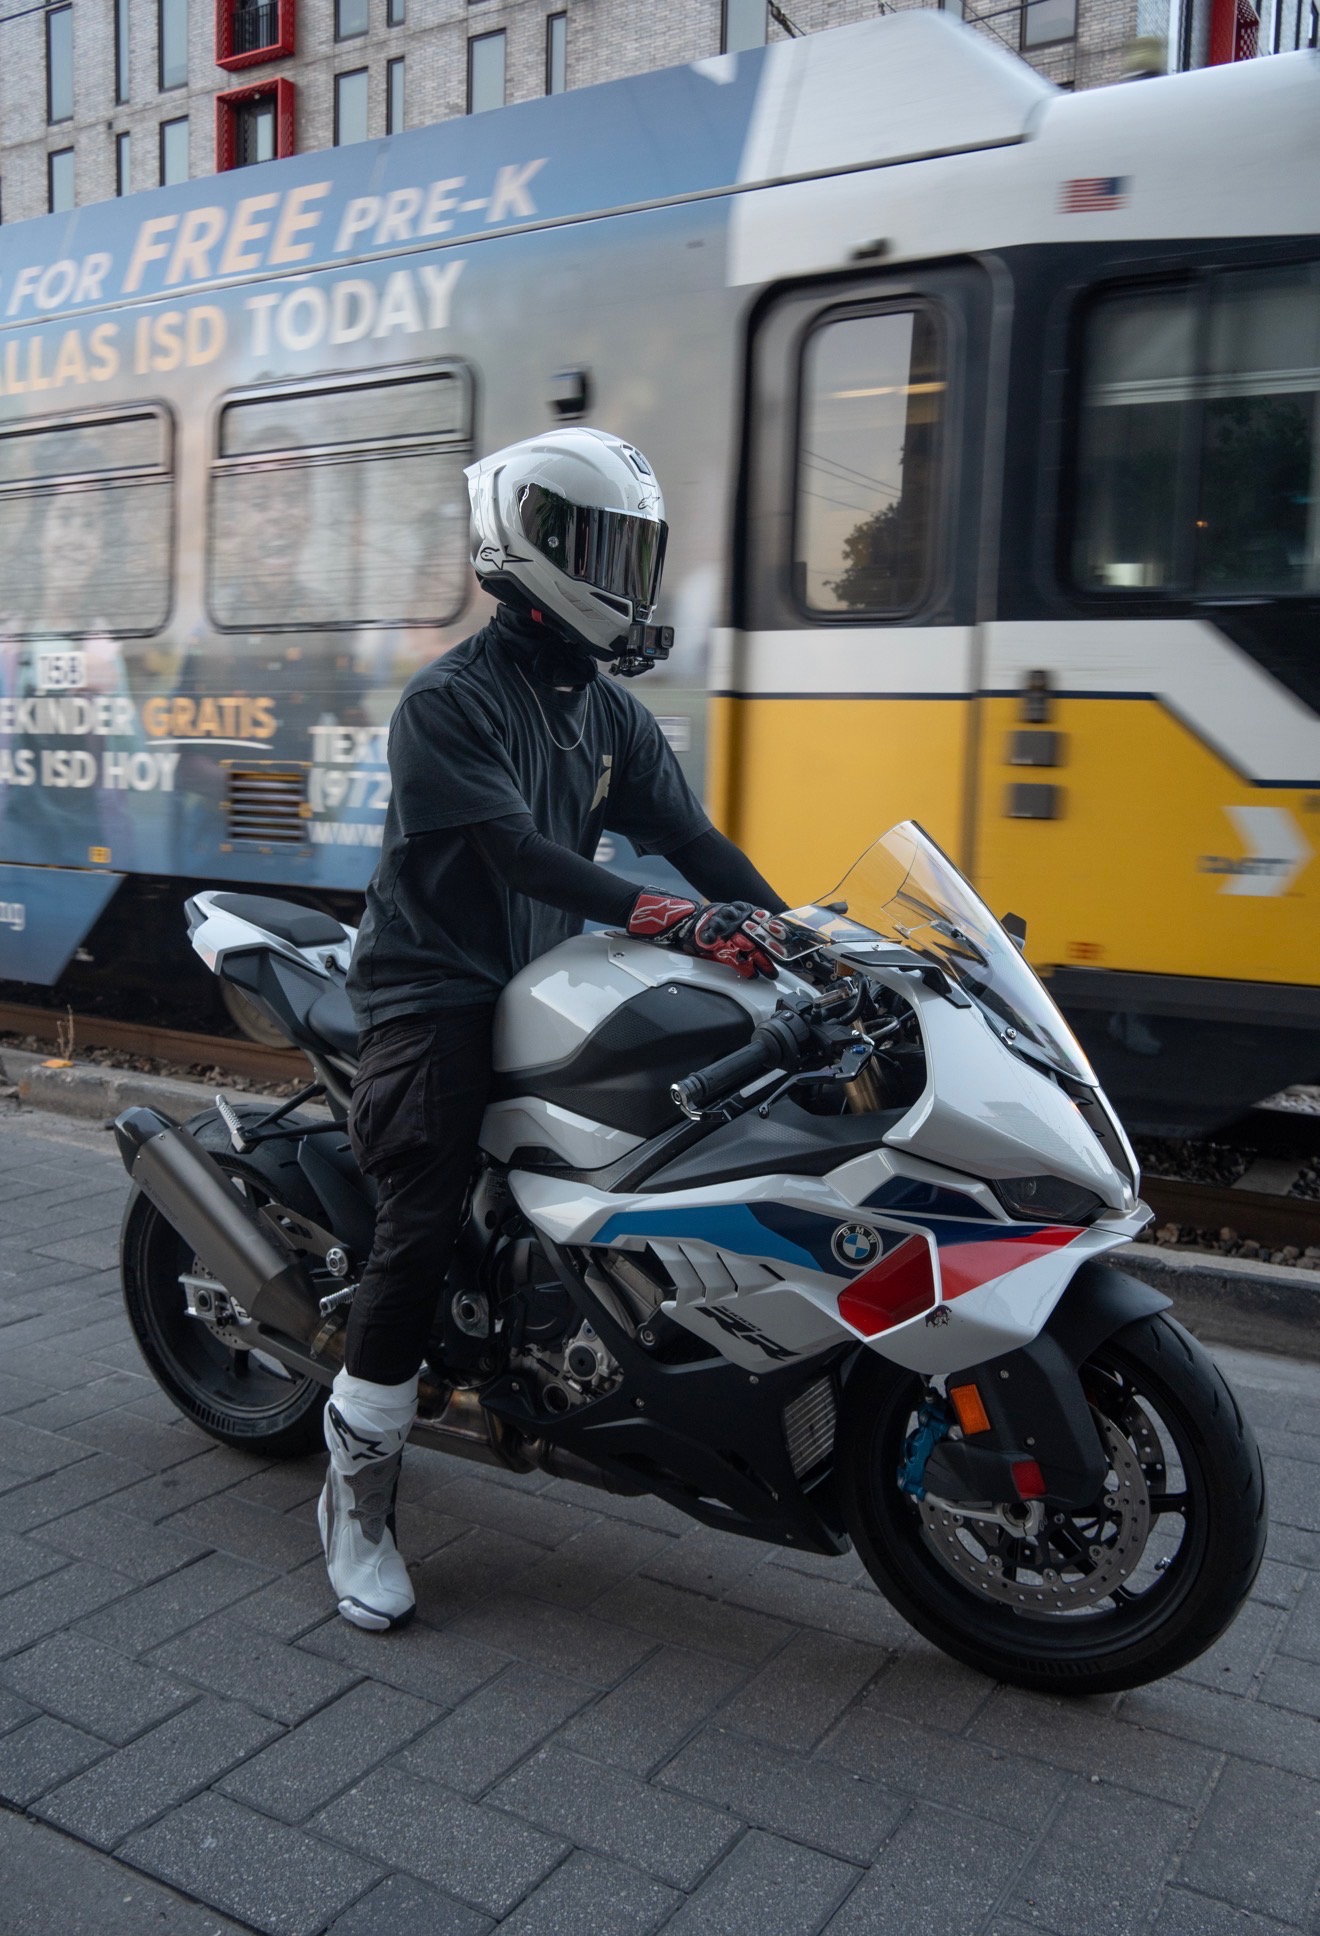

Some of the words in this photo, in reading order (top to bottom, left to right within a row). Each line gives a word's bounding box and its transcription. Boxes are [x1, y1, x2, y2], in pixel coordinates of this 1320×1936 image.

[5, 252, 113, 316] FOR
[121, 180, 334, 294] FREE
[332, 157, 551, 254] PRE-K
[0, 322, 119, 396] LLAS
[134, 305, 229, 375] ISD
[243, 259, 468, 356] TODAY
[0, 697, 136, 735] EKINDER
[143, 697, 277, 738] GRATIS
[41, 750, 97, 788] ISD
[102, 751, 181, 791] HOY
[308, 767, 392, 812] (972
[694, 1306, 801, 1361] RR
